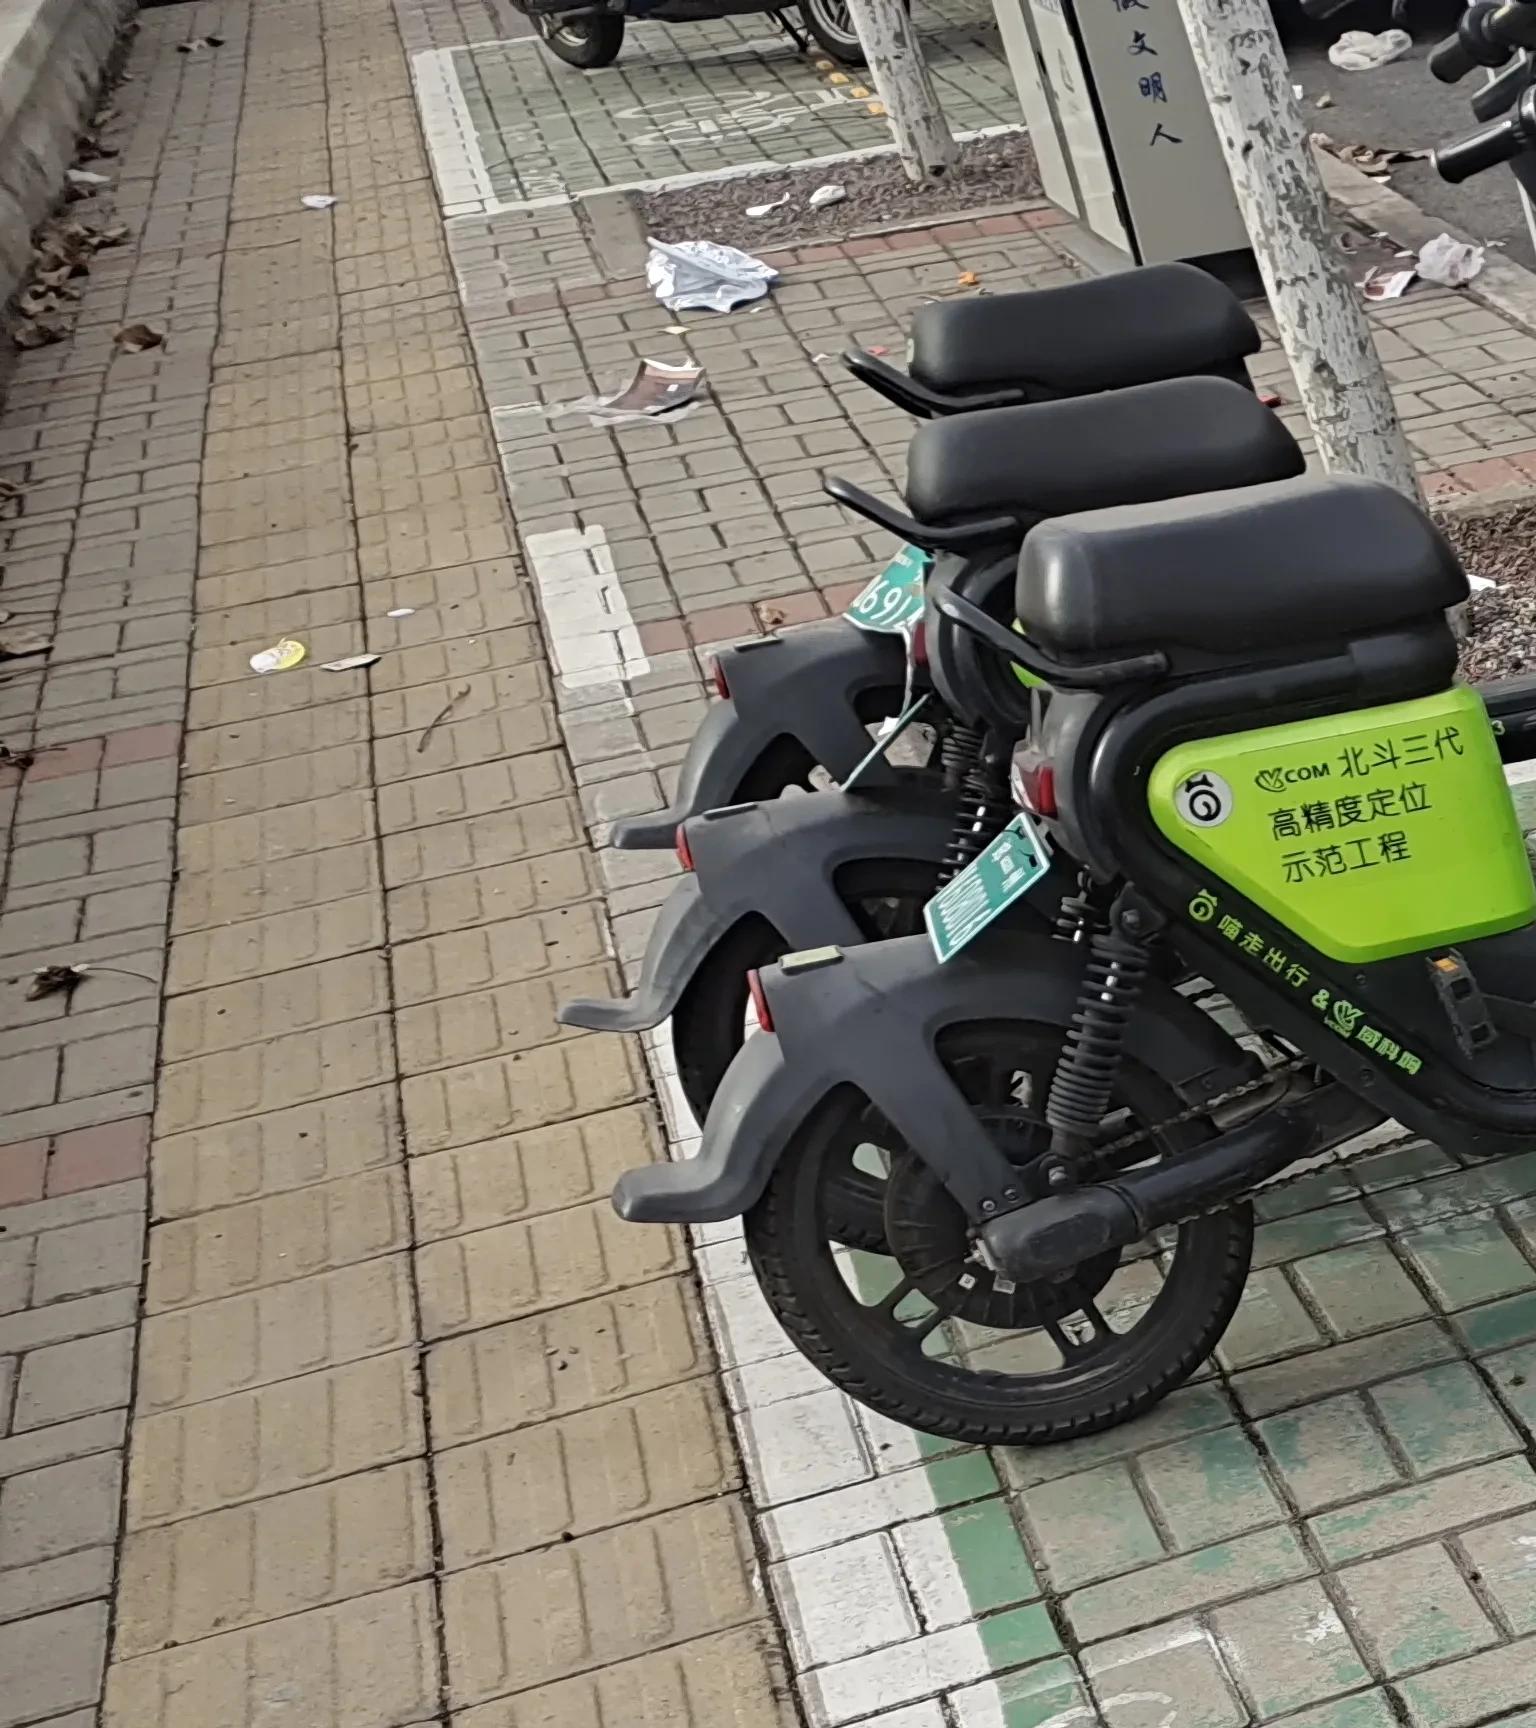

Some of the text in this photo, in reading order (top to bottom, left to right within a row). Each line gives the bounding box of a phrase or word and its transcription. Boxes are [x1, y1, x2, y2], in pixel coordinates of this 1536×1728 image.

[1337, 726, 1465, 779] 北斗三代
[1267, 781, 1433, 842] 高精度定位
[1281, 830, 1412, 884] 示范工程
[1311, 988, 1330, 1011] &
